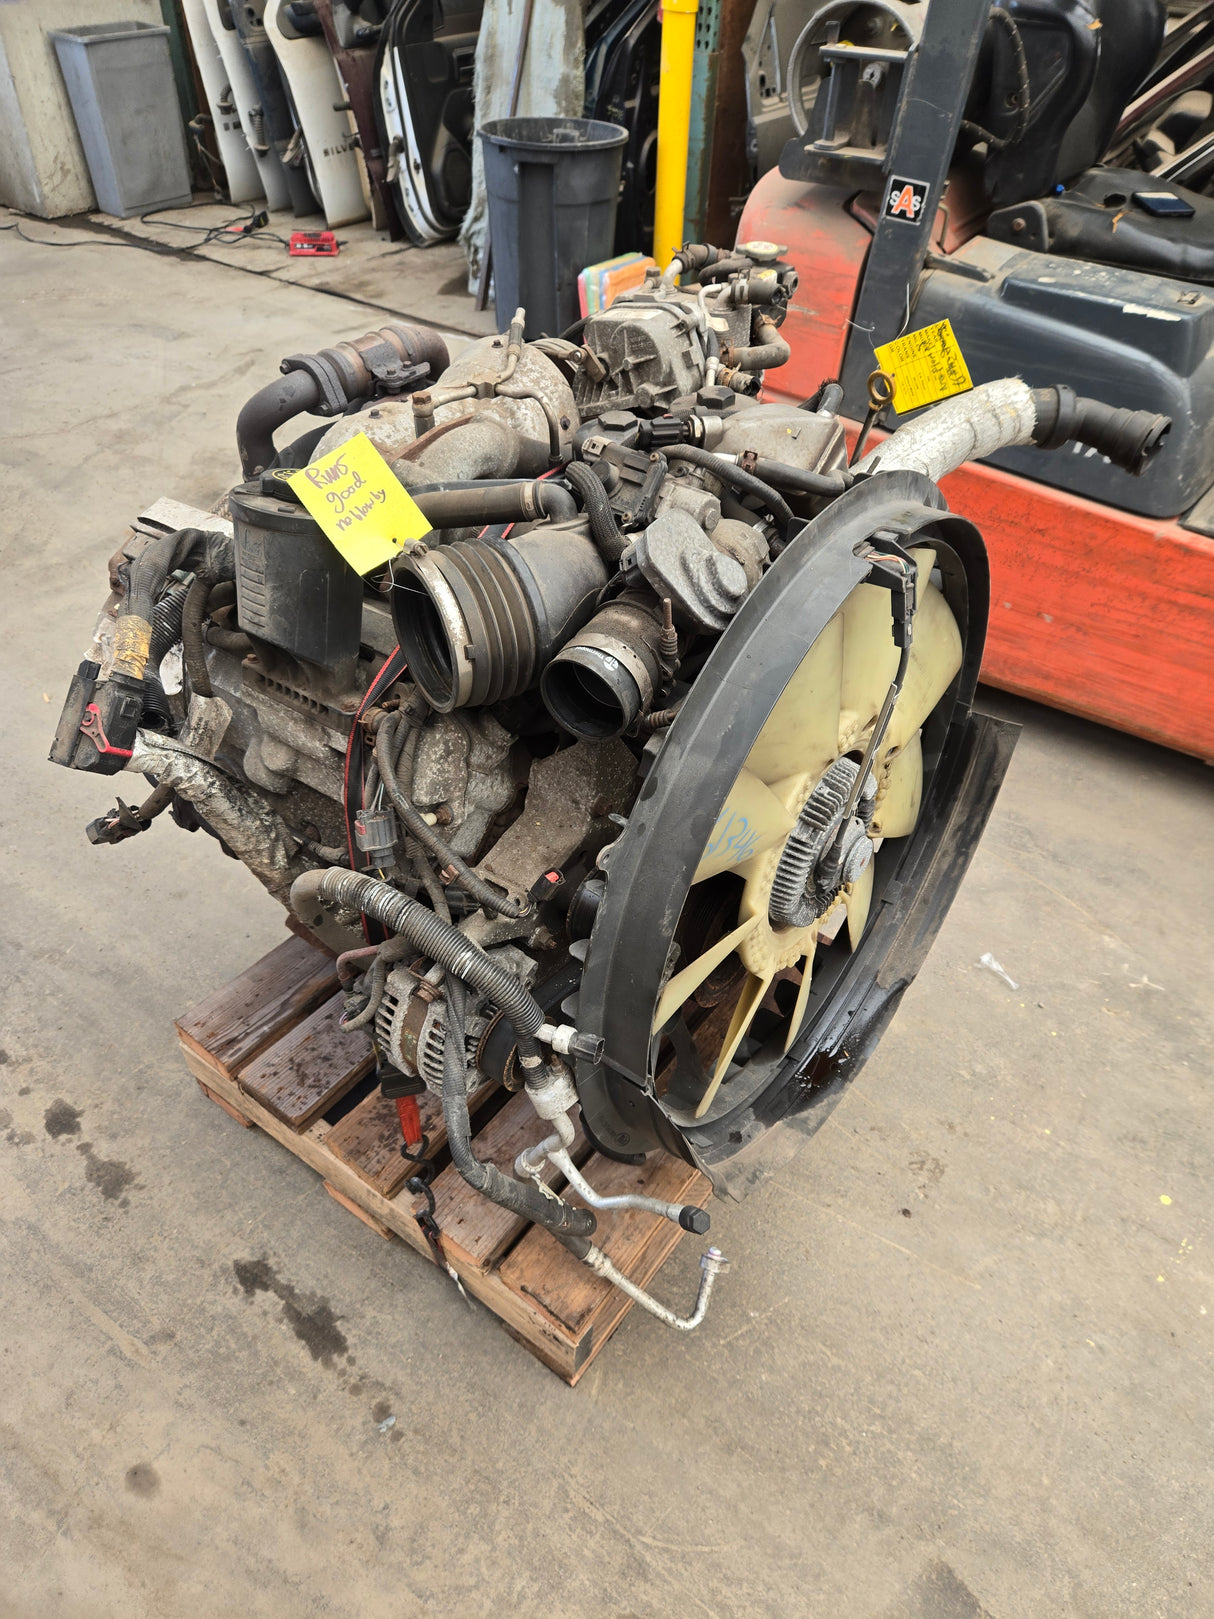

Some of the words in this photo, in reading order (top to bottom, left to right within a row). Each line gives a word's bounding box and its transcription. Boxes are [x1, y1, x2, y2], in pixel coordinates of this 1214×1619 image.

[304, 453, 348, 489] Runs
[326, 471, 367, 513] good
[336, 515, 353, 531] no
[349, 498, 375, 521] blow
[369, 489, 386, 504] by
